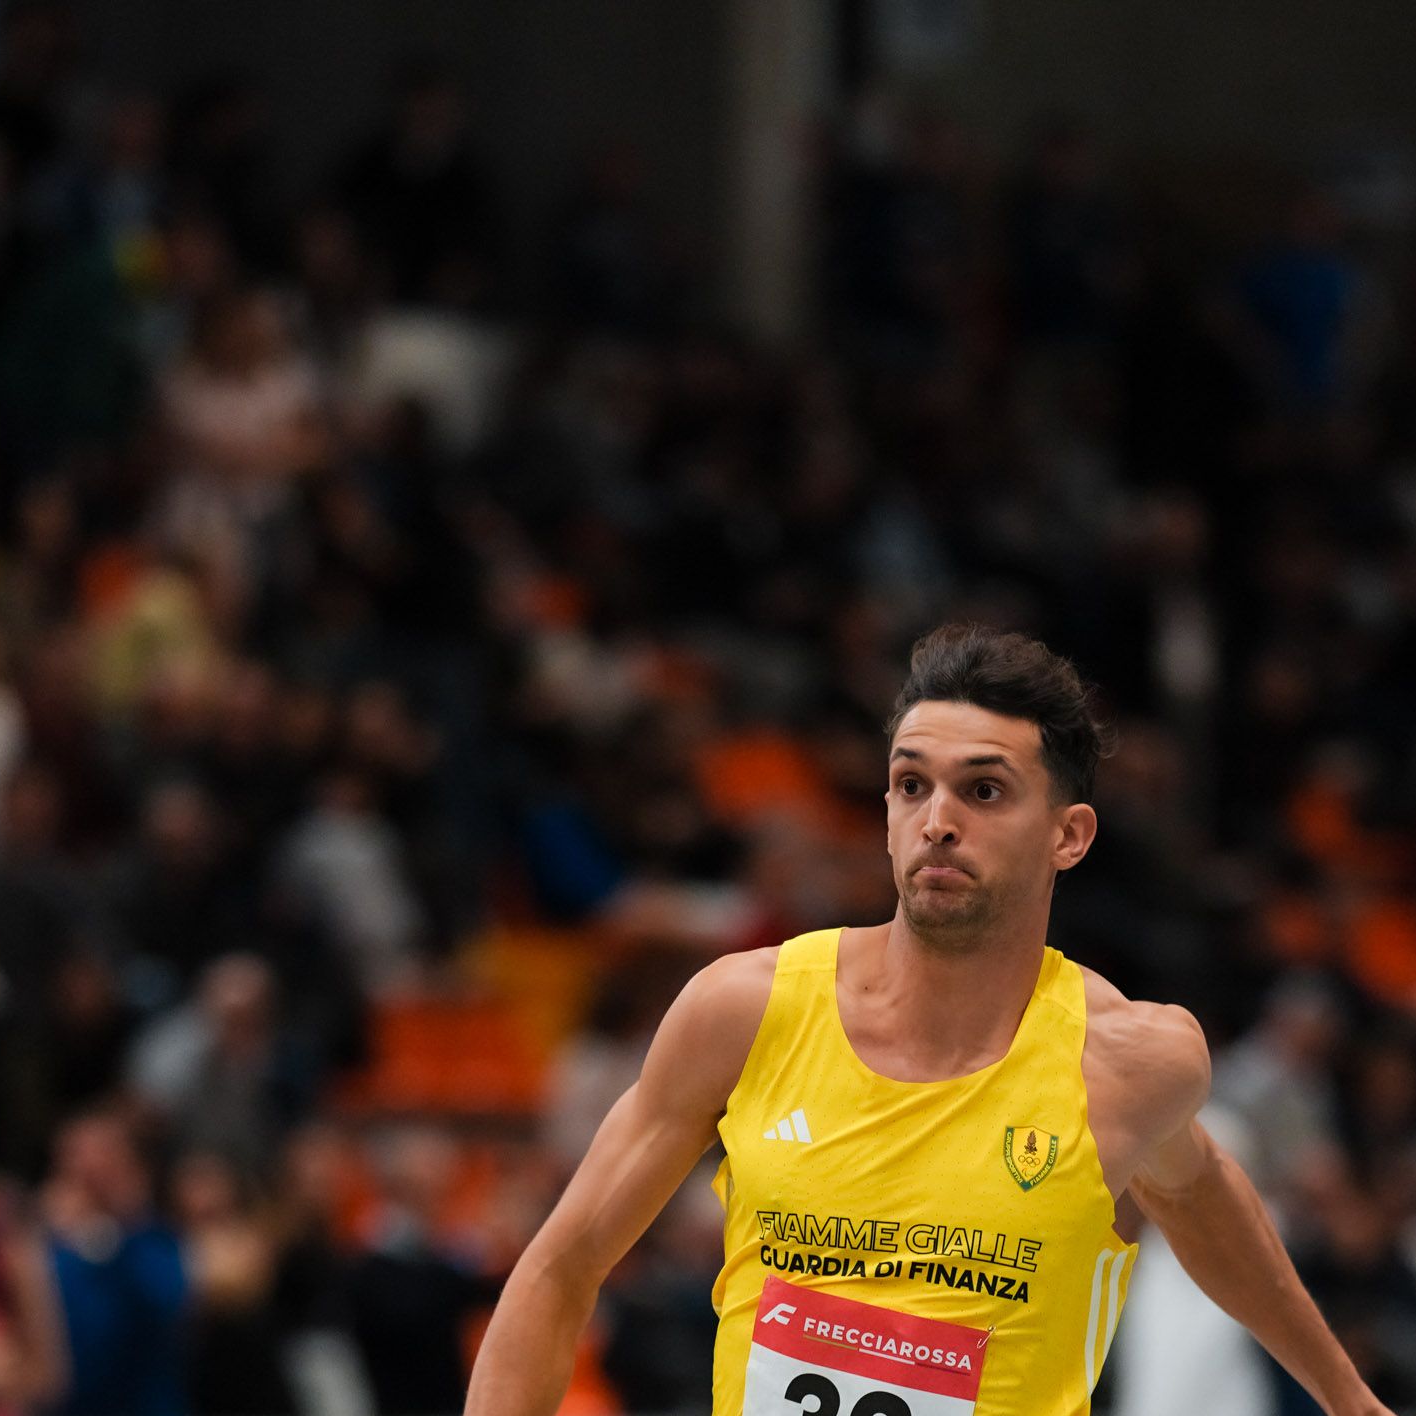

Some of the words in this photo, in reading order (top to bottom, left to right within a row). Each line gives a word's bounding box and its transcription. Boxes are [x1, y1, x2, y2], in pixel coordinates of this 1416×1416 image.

[1029, 1163, 1052, 1187] FIAMME
[1048, 1140, 1057, 1164] GIALLE
[756, 1211, 900, 1253] FIAMME
[905, 1223, 1042, 1272] GIALLE
[760, 1245, 867, 1278] GUARDIA
[874, 1260, 903, 1279] DI
[908, 1261, 1029, 1303] FINANZA
[803, 1317, 972, 1371] FRECCIAROSSA
